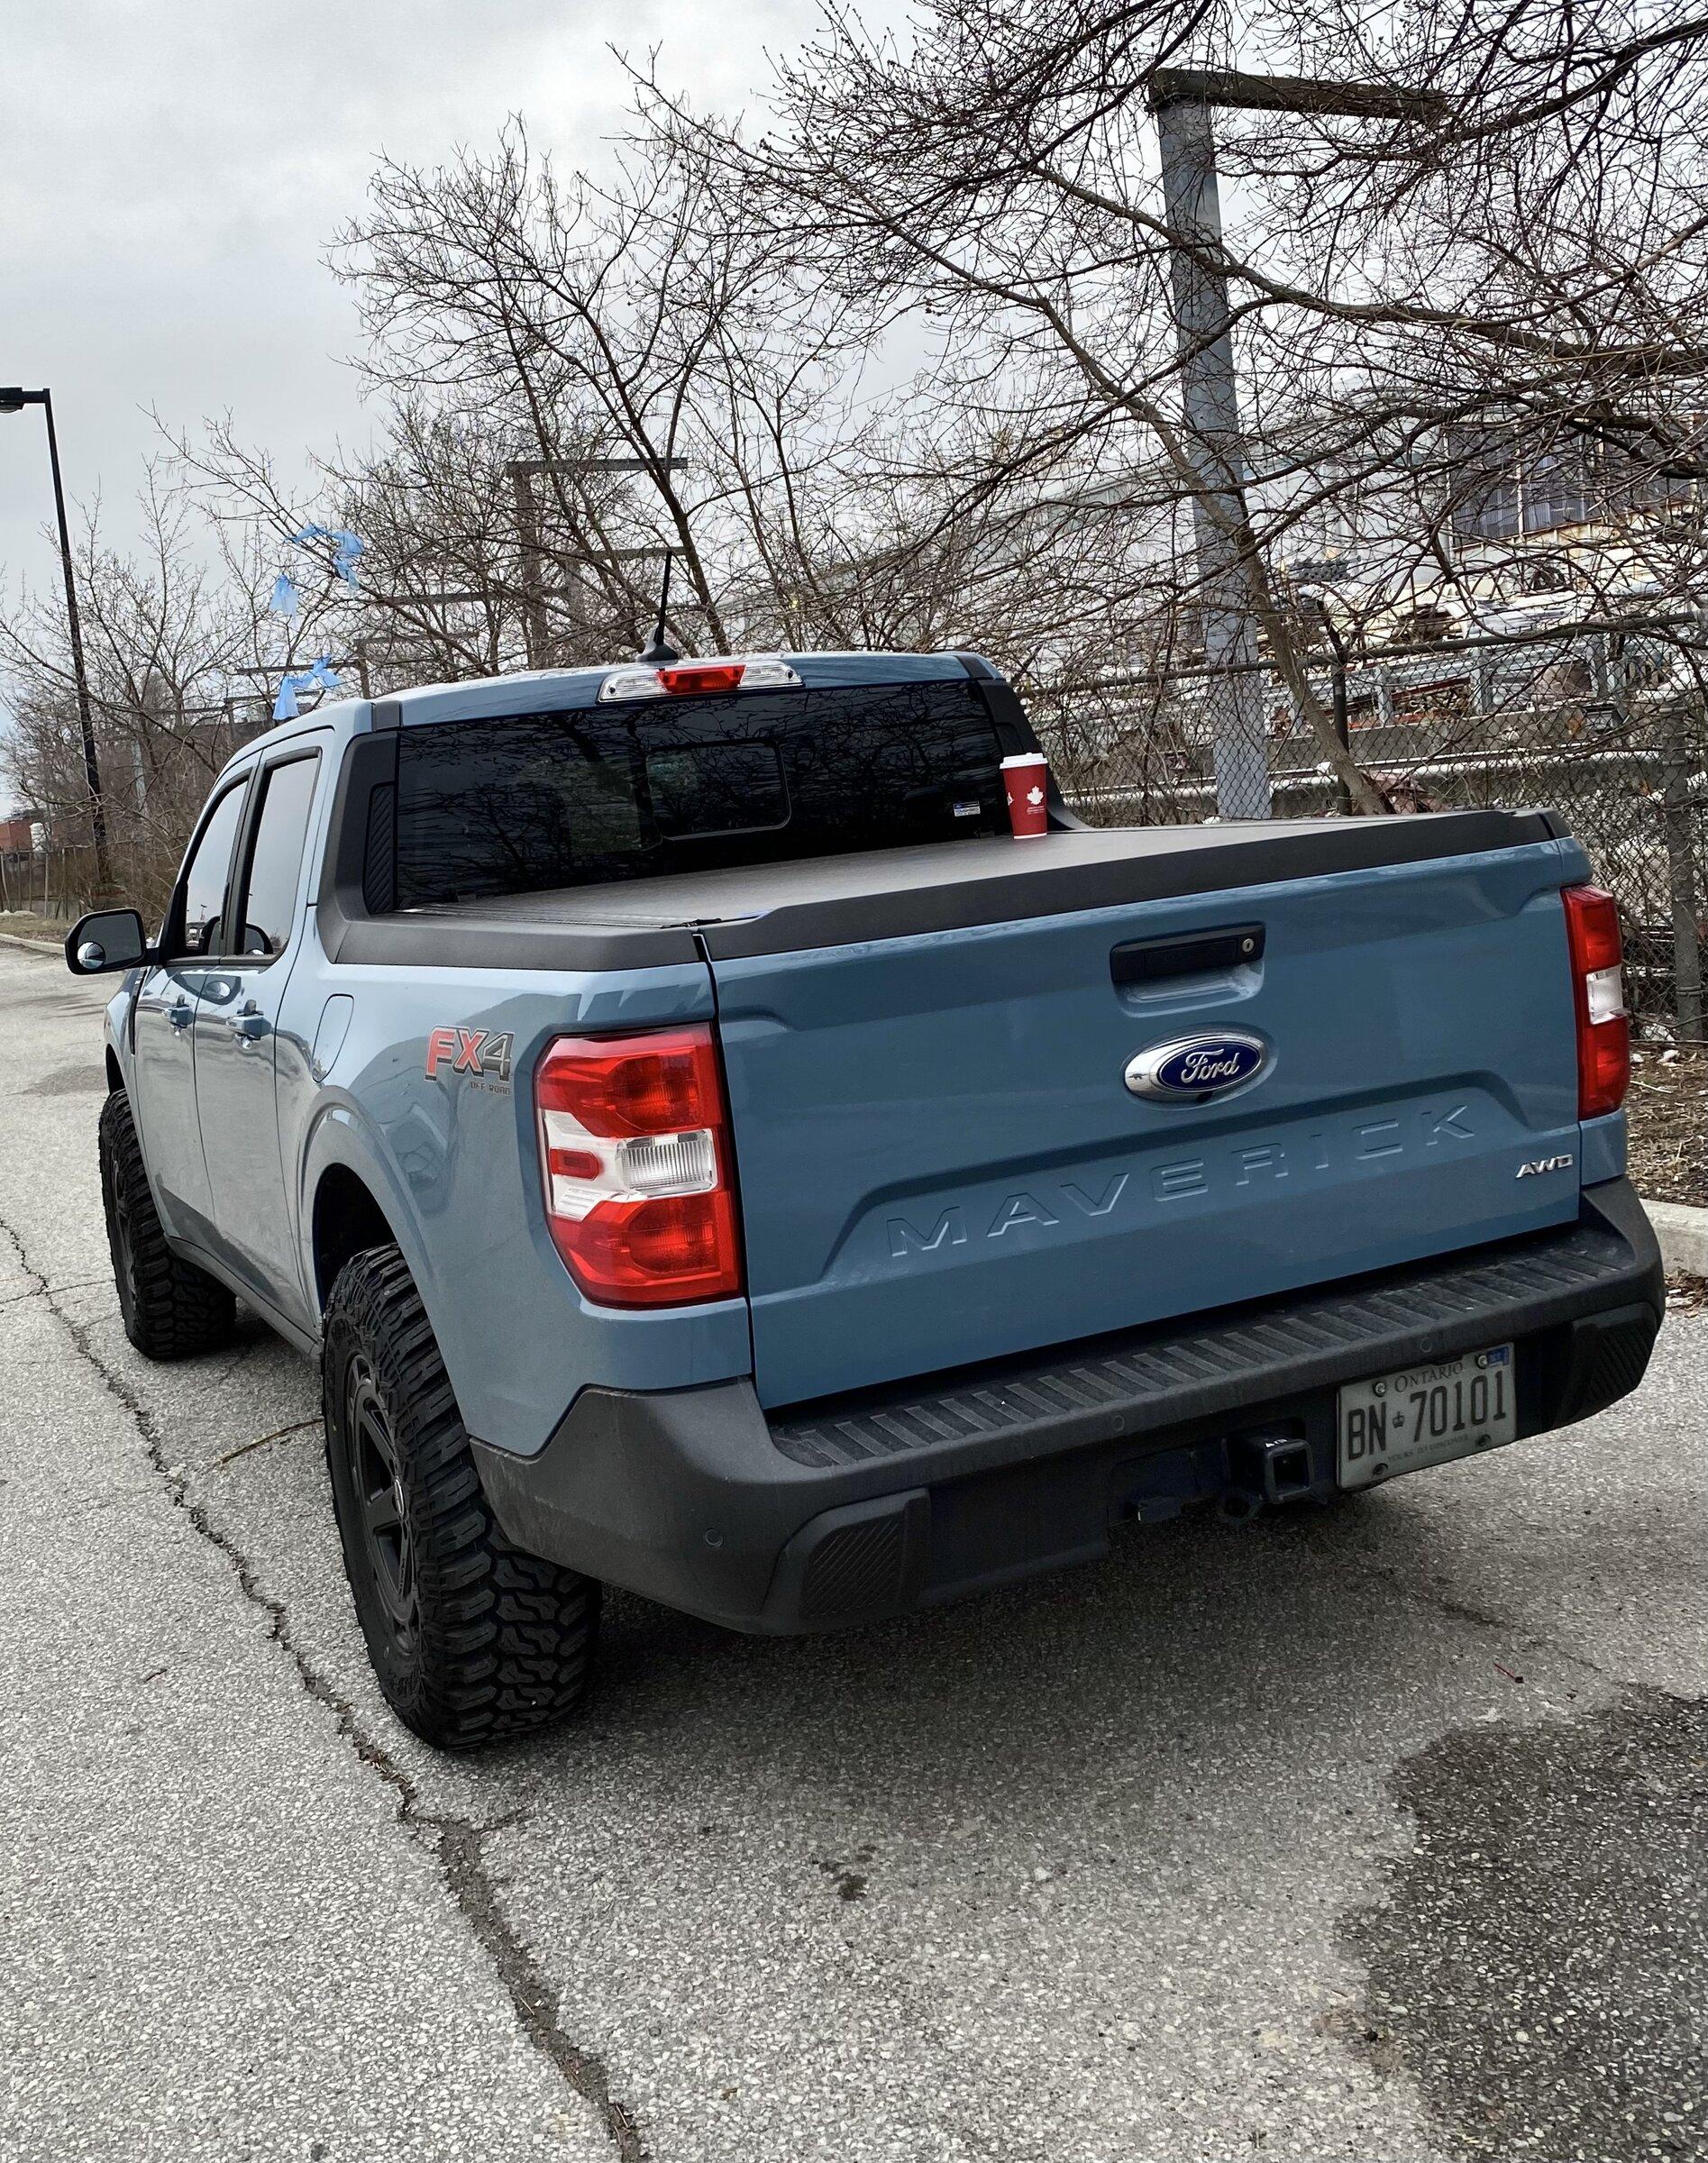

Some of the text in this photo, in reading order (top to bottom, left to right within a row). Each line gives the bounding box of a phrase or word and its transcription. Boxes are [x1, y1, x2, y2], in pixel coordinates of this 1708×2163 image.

[425, 1024, 515, 1082] FX4
[1181, 1048, 1240, 1083] Ford
[470, 1081, 511, 1095] OFF ROAD
[886, 1104, 1475, 1256] MAVERICK
[1515, 1154, 1574, 1179] AWD
[1394, 1361, 1464, 1393] ONTARIO
[1348, 1370, 1506, 1462] BN 70101
